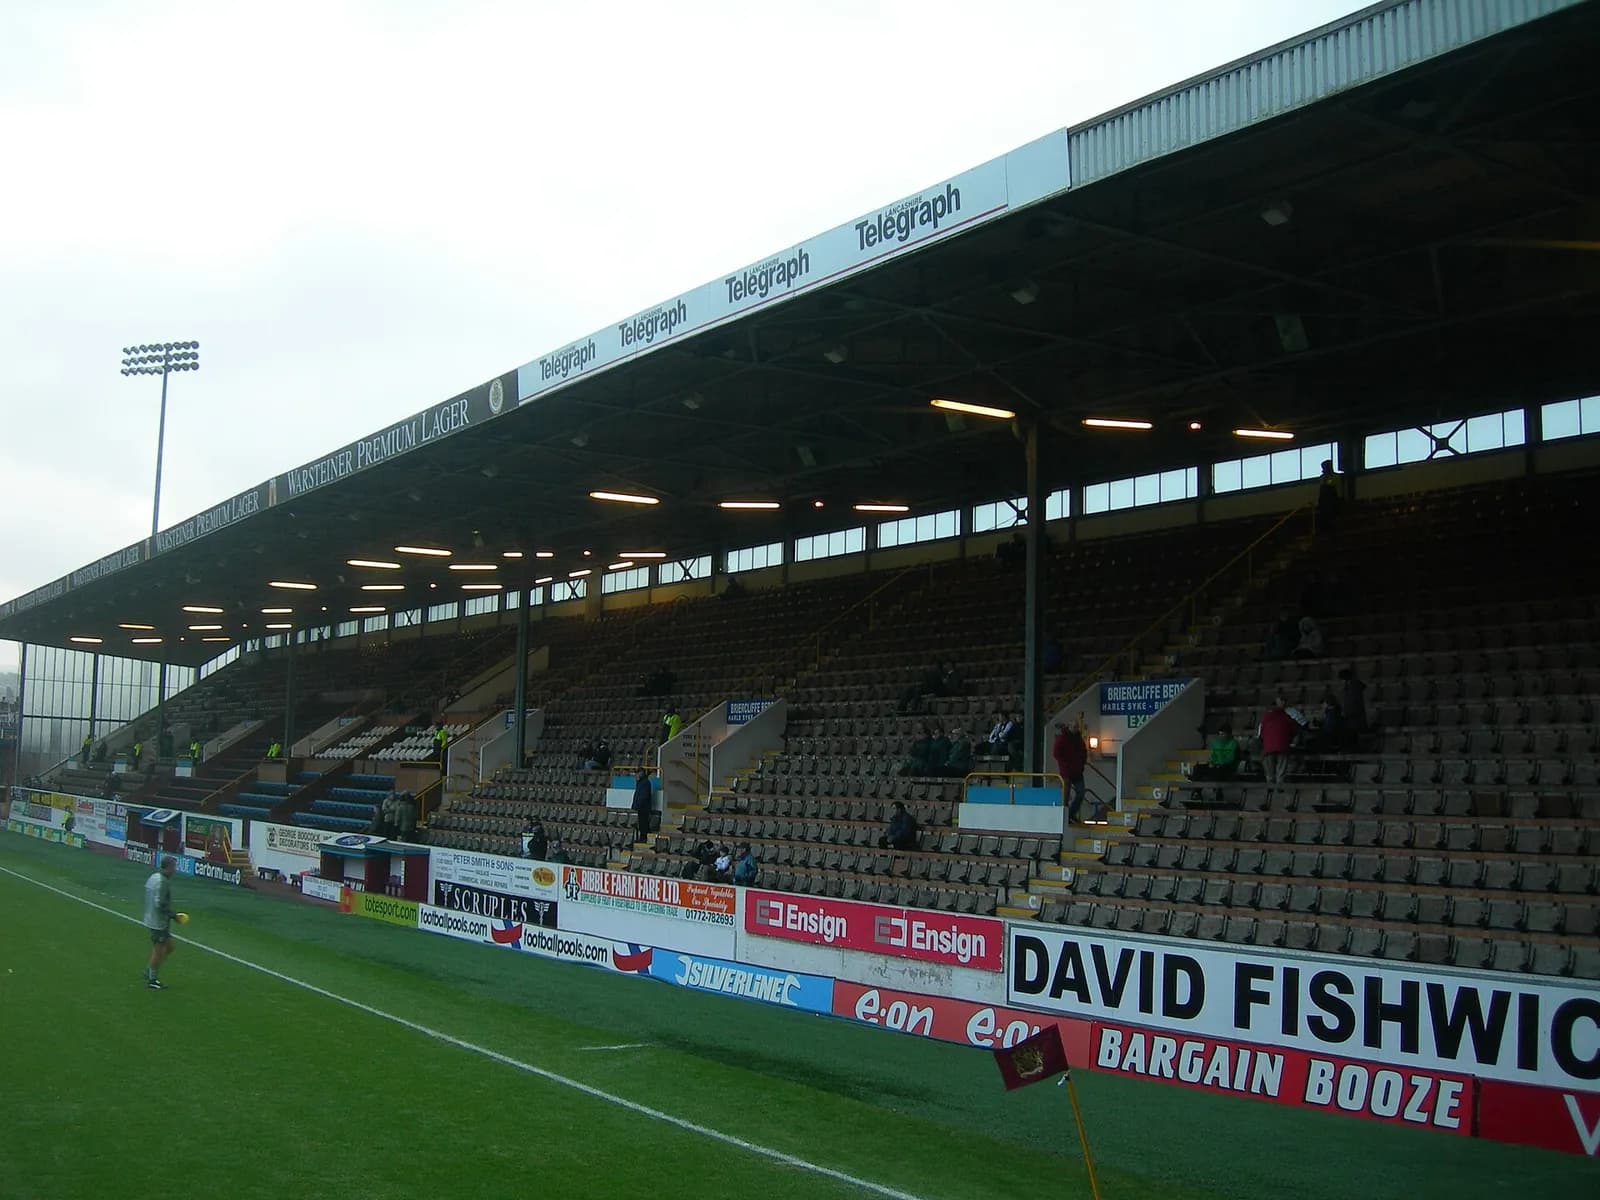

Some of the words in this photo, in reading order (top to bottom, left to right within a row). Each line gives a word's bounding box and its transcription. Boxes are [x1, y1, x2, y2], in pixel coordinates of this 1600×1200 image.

[855, 183, 960, 250] Telegraph
[885, 195, 922, 218] LANCASHIRE
[725, 248, 809, 303] Telegraph
[618, 299, 686, 347] Telegraph
[539, 338, 595, 381] Telegraph
[287, 450, 352, 496] WARSTEINER
[357, 421, 416, 469] PREMIUM
[421, 398, 469, 442] LAGER
[232, 490, 259, 520] LAGER
[1107, 685, 1160, 701] BRIERCLIFFE
[1128, 702, 1146, 710] SYKE
[1130, 715, 1151, 727] EX
[1153, 788, 1161, 799] G
[279, 828, 296, 839] GEORGE
[279, 838, 309, 851] DECORATORS
[453, 854, 472, 865] PETER
[472, 856, 490, 867] SMITH
[496, 861, 514, 872] SONS
[581, 869, 609, 895] RIBBLE
[611, 874, 636, 899] FARM
[638, 877, 661, 901] FARE
[662, 880, 682, 905] LTD.
[365, 896, 417, 921] totesport.com
[453, 887, 528, 923] SCRUPLES
[685, 908, 734, 926] 01772-782693
[420, 908, 488, 937] footballpools.com
[786, 904, 847, 942] Ensign
[524, 928, 608, 962] footballpools.com
[911, 921, 986, 963] Ensign
[1014, 934, 1206, 1020] DAVID
[1098, 1028, 1284, 1098] BARGAIN
[1304, 1058, 1464, 1130] BOOZE
